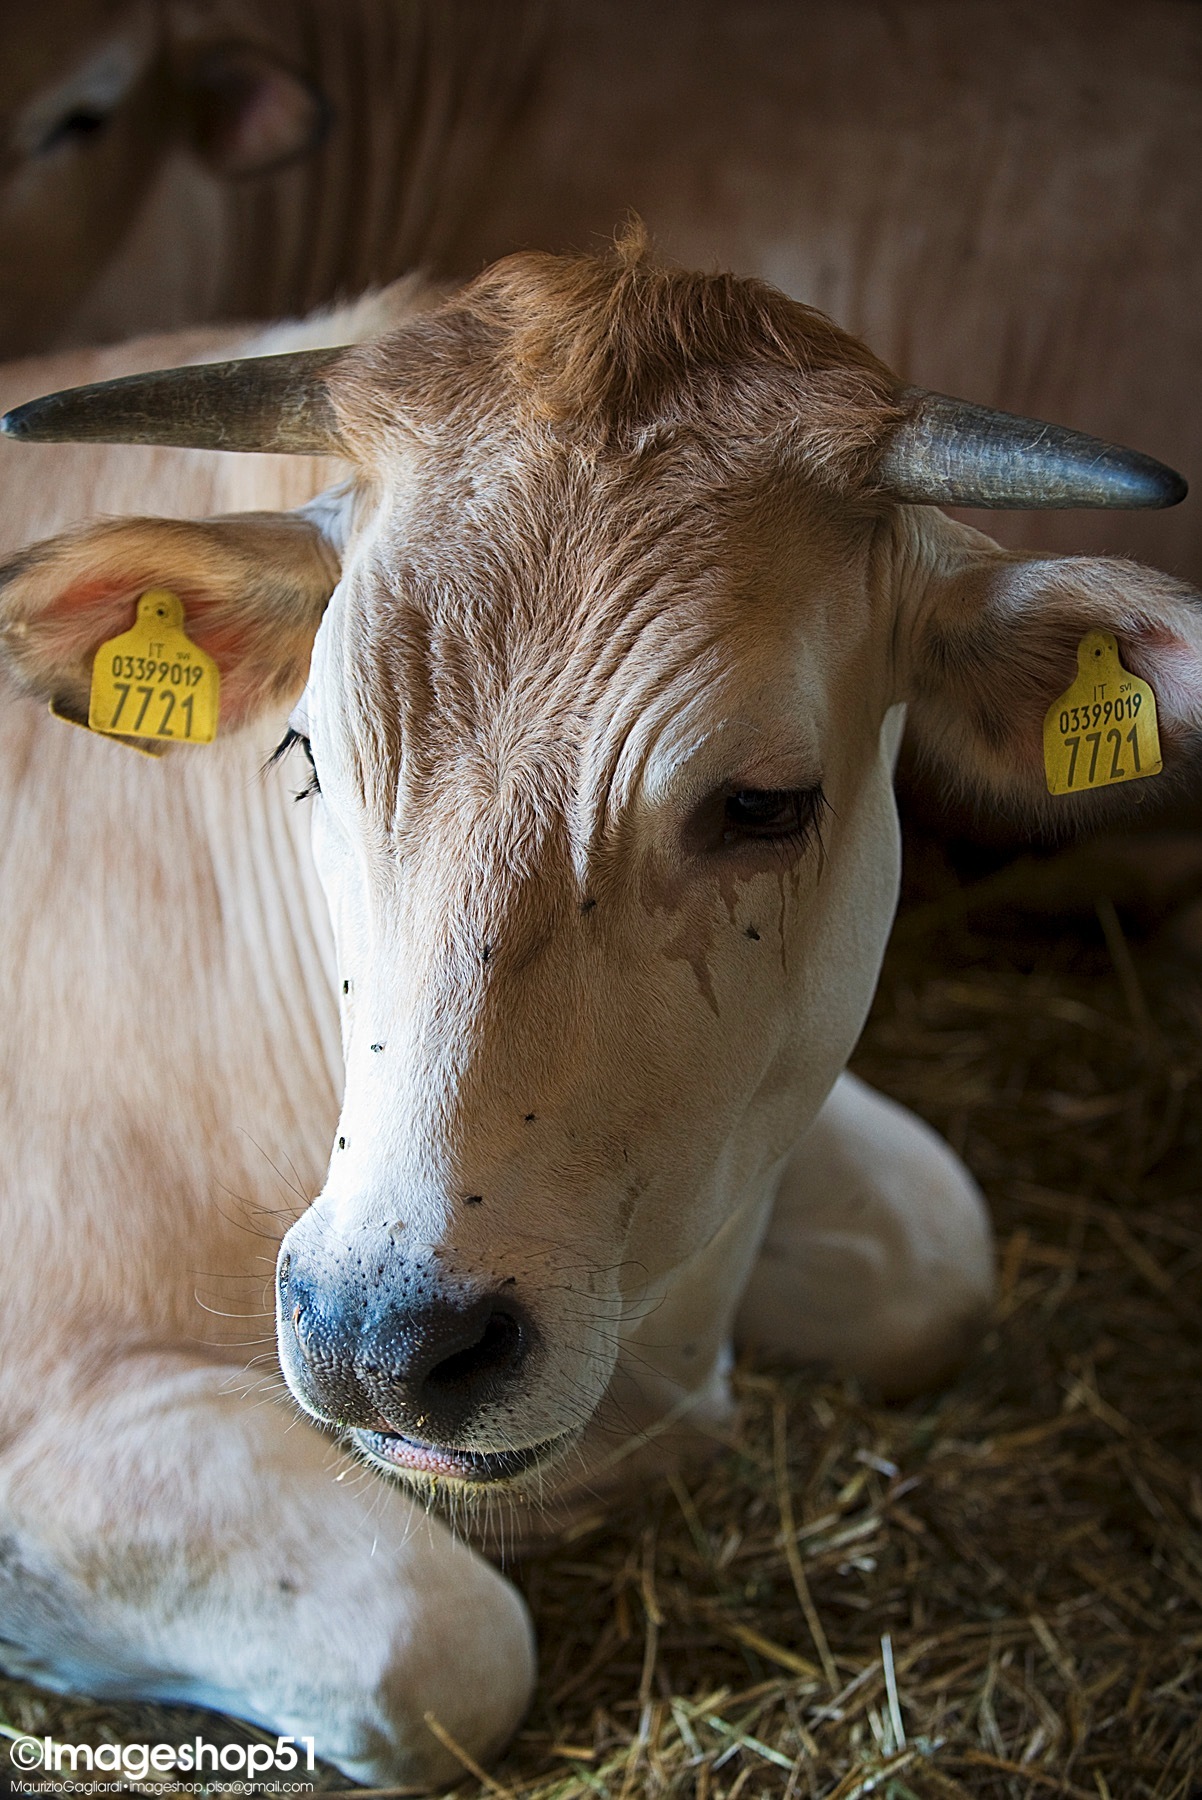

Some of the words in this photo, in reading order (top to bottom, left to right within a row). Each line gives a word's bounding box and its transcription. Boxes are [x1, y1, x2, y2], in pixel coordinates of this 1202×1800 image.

[148, 642, 165, 659] IT
[111, 655, 203, 687] 03399019
[110, 682, 195, 738] 7721
[1093, 683, 1107, 702] IT
[1059, 692, 1142, 735] 03399019
[1064, 723, 1141, 788] 7721
